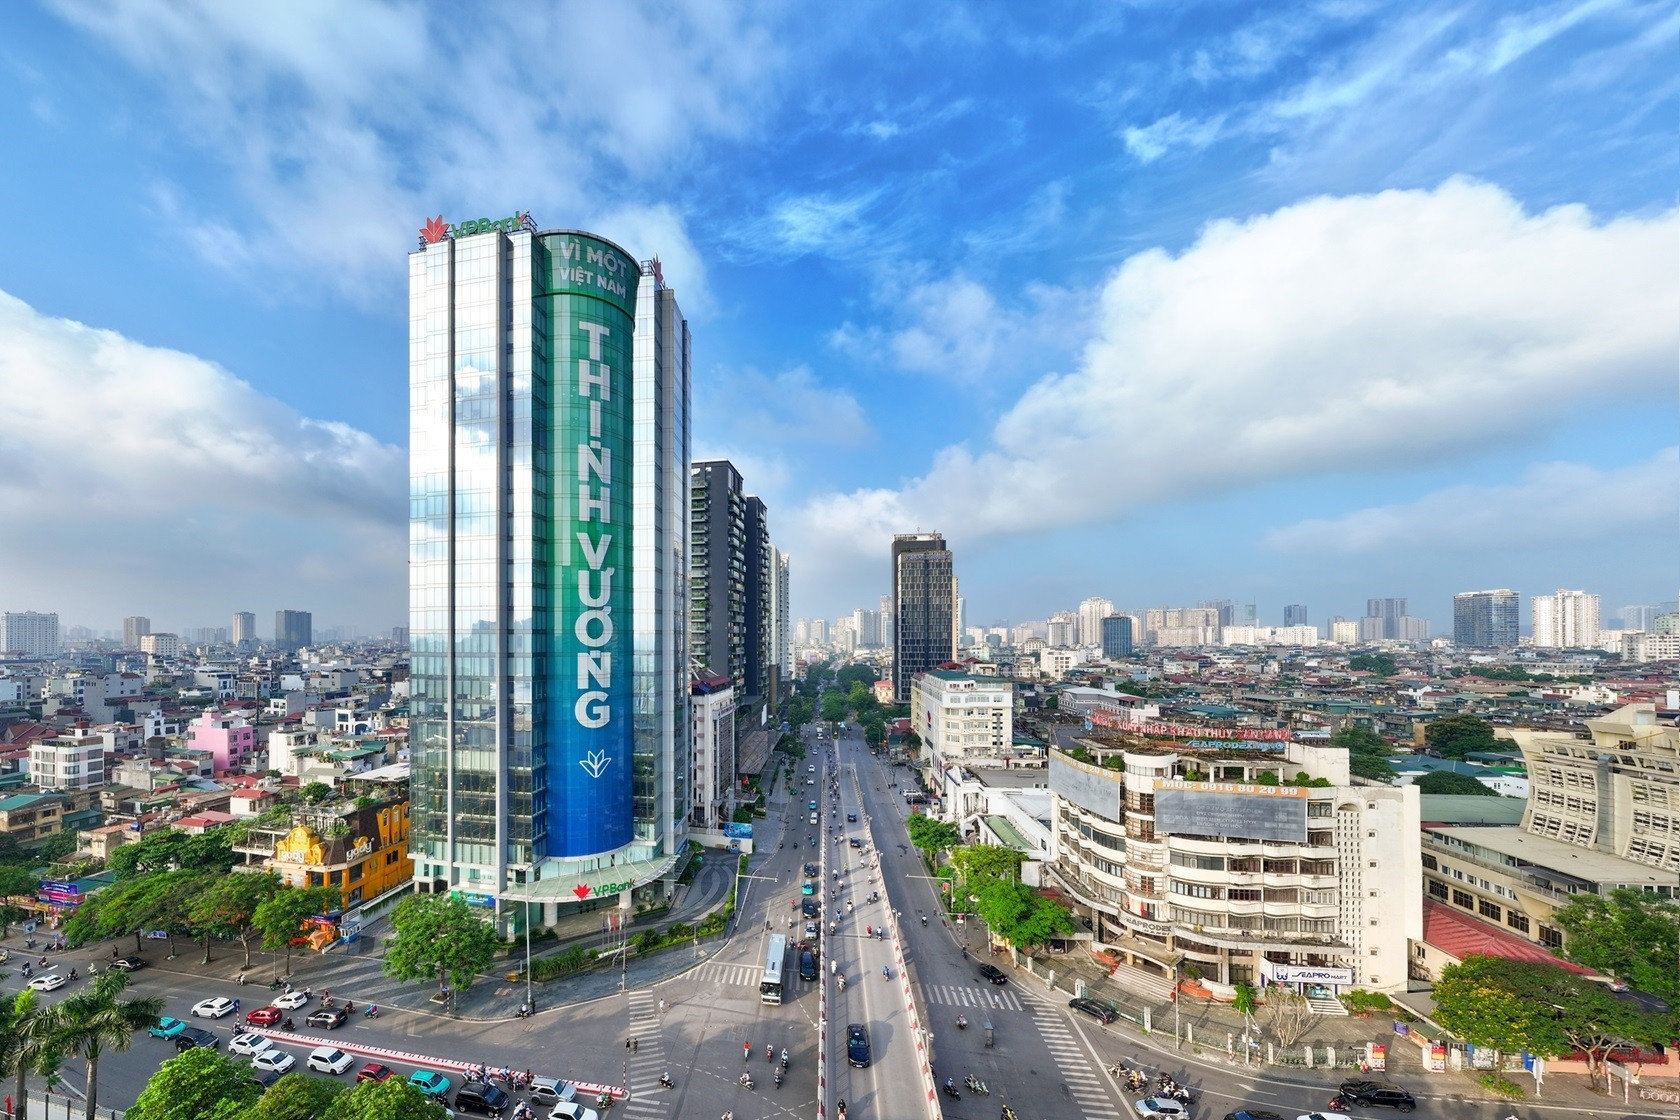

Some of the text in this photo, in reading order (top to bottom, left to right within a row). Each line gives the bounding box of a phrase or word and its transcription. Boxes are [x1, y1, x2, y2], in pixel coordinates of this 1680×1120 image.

[451, 211, 526, 238] VPBank
[560, 239, 627, 277] VÌ MỘT
[559, 266, 626, 299] VIỆT NAM
[578, 321, 611, 523] THỊNH
[575, 532, 615, 729] VƯỢNG
[593, 878, 636, 897] VPBank
[1292, 971, 1330, 979] SEAPRO
